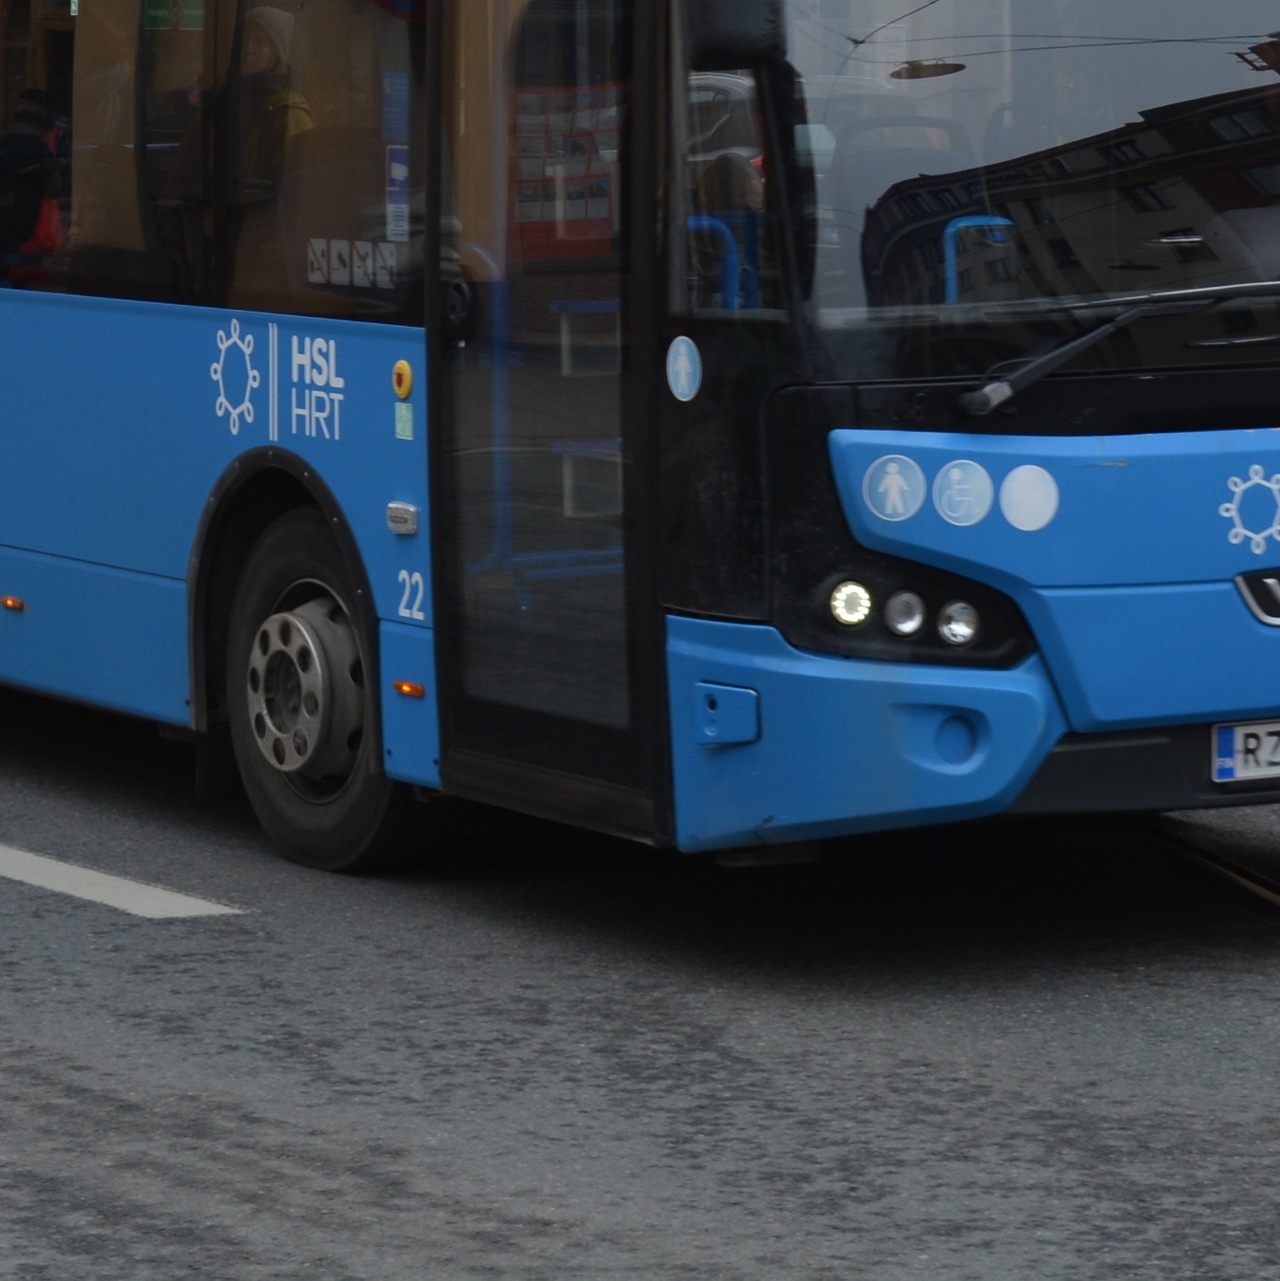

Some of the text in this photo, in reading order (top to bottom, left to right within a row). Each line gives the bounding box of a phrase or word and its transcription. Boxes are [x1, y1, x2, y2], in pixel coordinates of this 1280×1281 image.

[291, 335, 345, 389] HSL
[291, 387, 344, 441] HRT
[398, 569, 426, 620] 22
